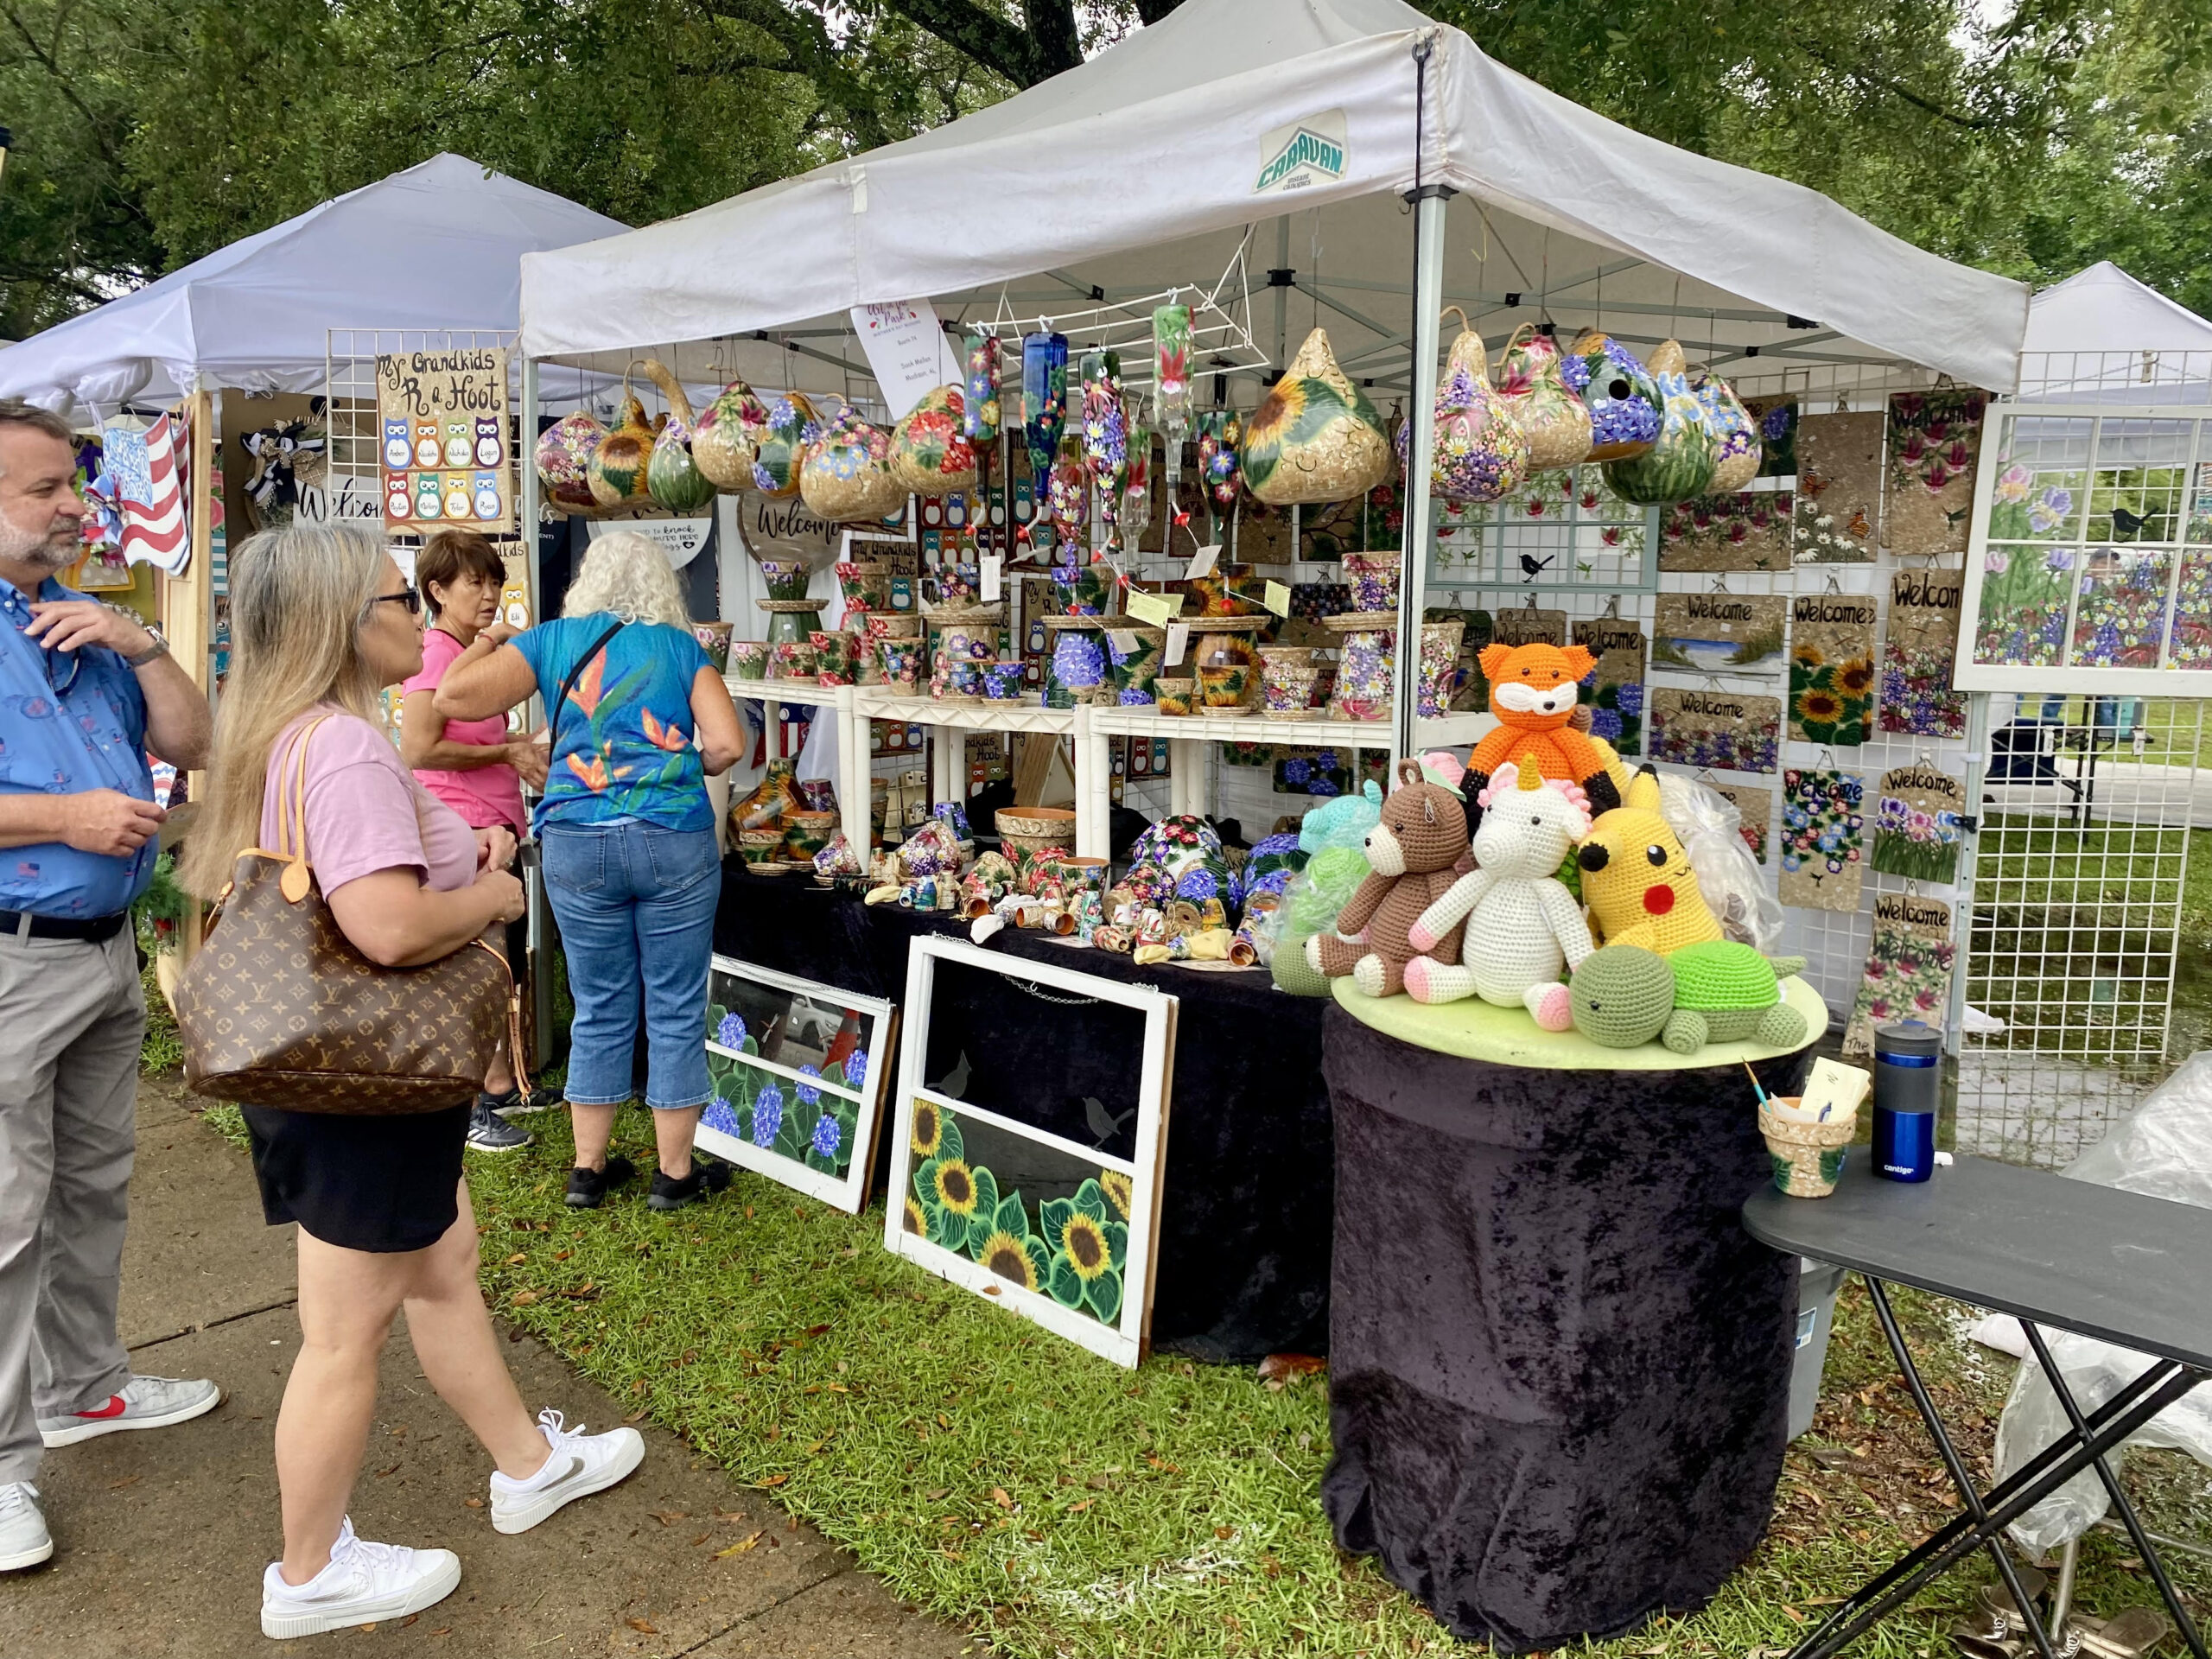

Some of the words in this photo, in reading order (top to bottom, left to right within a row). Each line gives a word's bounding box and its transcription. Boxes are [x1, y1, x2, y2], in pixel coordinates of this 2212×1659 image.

[1256, 133, 1343, 189] CARAVAN
[376, 354, 406, 391] My
[411, 349, 496, 373] Grandkids
[401, 377, 429, 416] R
[432, 386, 442, 404] a
[445, 375, 501, 411] Hoot
[757, 499, 842, 545] Welcome
[1687, 595, 1753, 621] Welcome
[1794, 597, 1866, 624] Welcome
[1572, 623, 1638, 650] Welcome
[1680, 692, 1744, 718] Welcome
[1887, 767, 1957, 798] Welcome
[1875, 895, 1949, 927] Welcome
[1847, 1037, 1870, 1052] The
[1884, 1164, 1914, 1175] contigo
